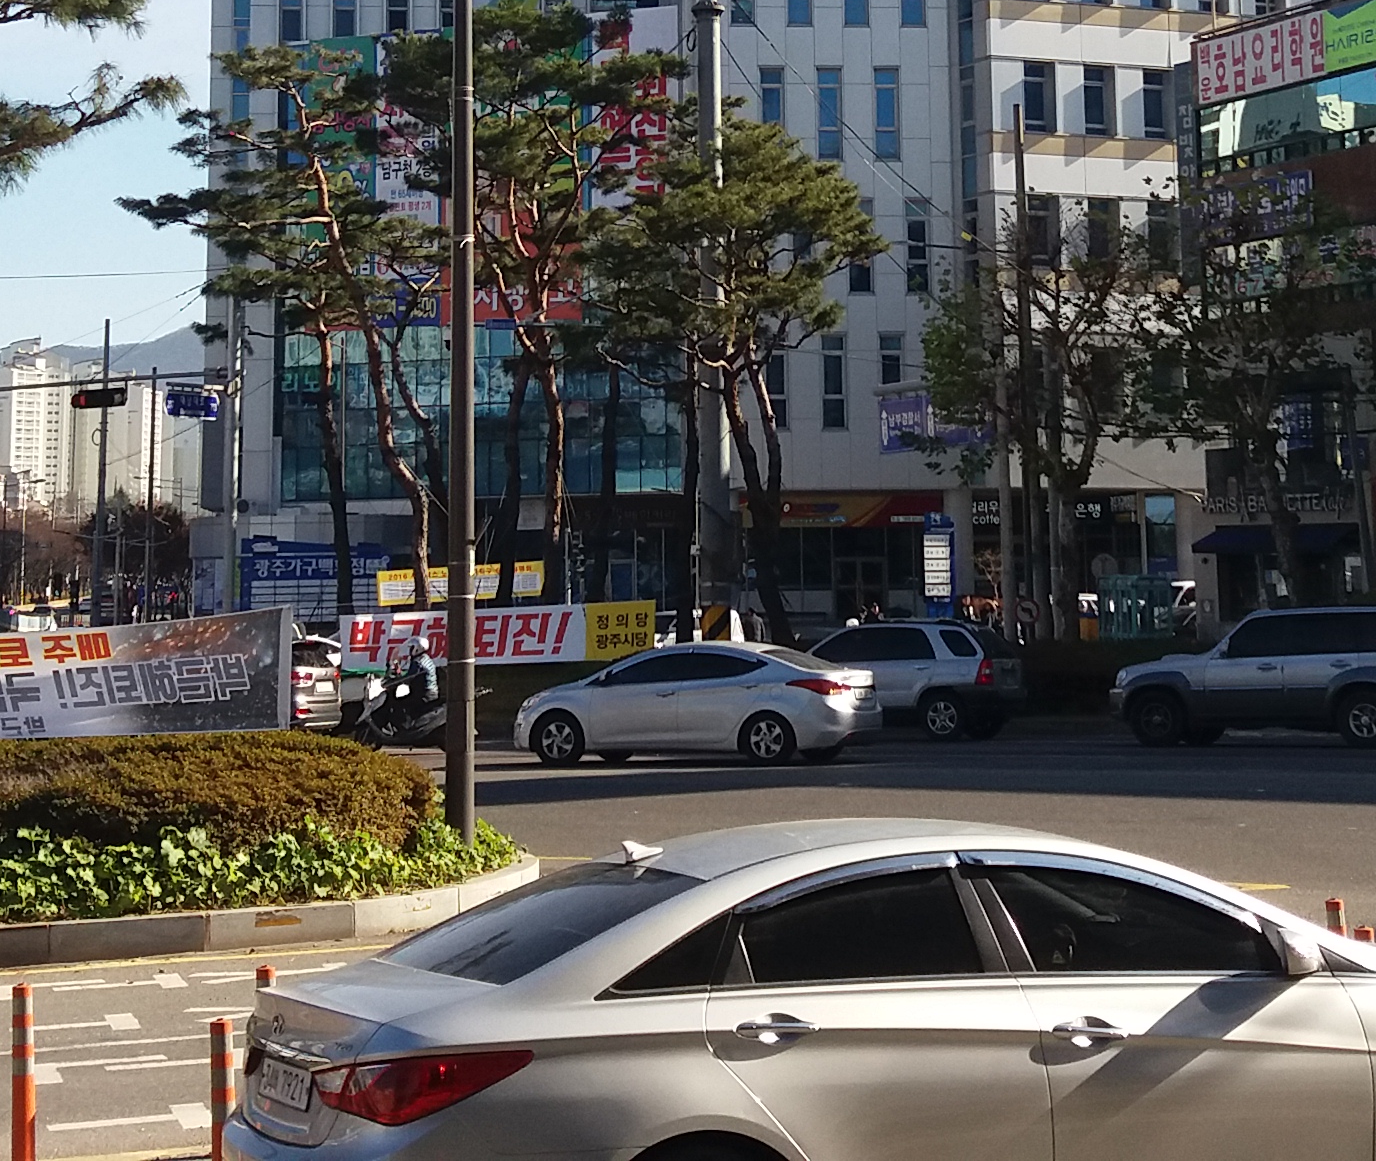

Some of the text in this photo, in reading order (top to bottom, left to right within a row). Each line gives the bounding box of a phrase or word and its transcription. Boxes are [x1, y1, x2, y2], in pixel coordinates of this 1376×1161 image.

[1214, 11, 1324, 95] 호남요리학원
[253, 558, 366, 578] 광주가구백점
[594, 631, 650, 651] 광주시당
